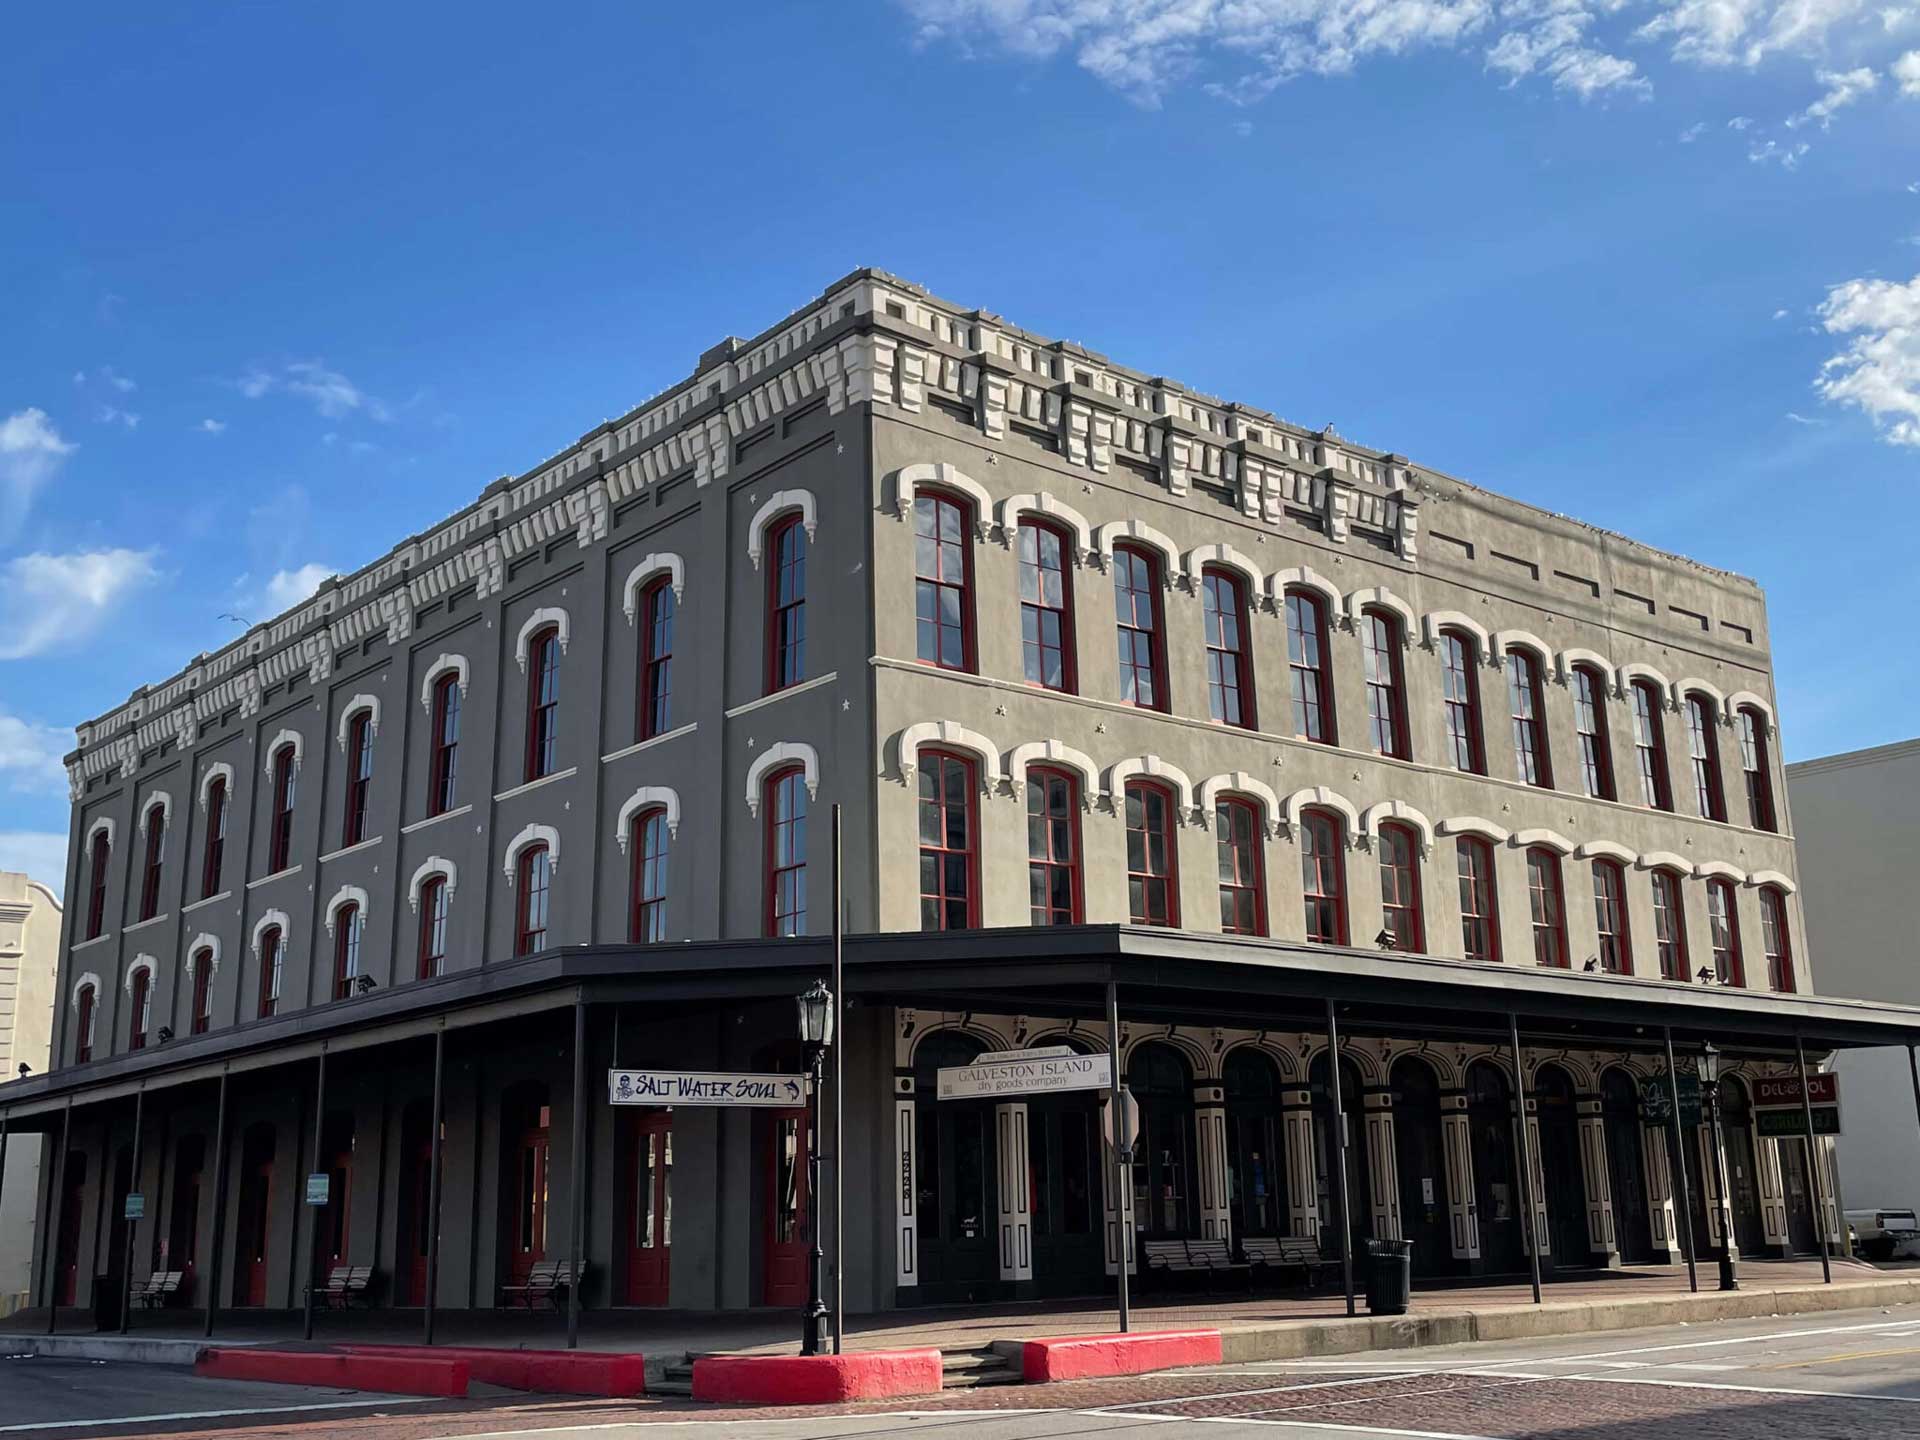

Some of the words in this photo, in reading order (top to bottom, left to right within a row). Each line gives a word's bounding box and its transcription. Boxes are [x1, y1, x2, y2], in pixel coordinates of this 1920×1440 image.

[958, 1064, 1035, 1082] GALVESTON
[1041, 1060, 1093, 1076] ISLAND
[635, 1075, 677, 1096] SALT
[678, 1077, 734, 1098] WATER
[735, 1079, 781, 1099] SOUL
[977, 1078, 992, 1091] dry
[995, 1076, 1023, 1091] goods
[1025, 1076, 1068, 1089] company
